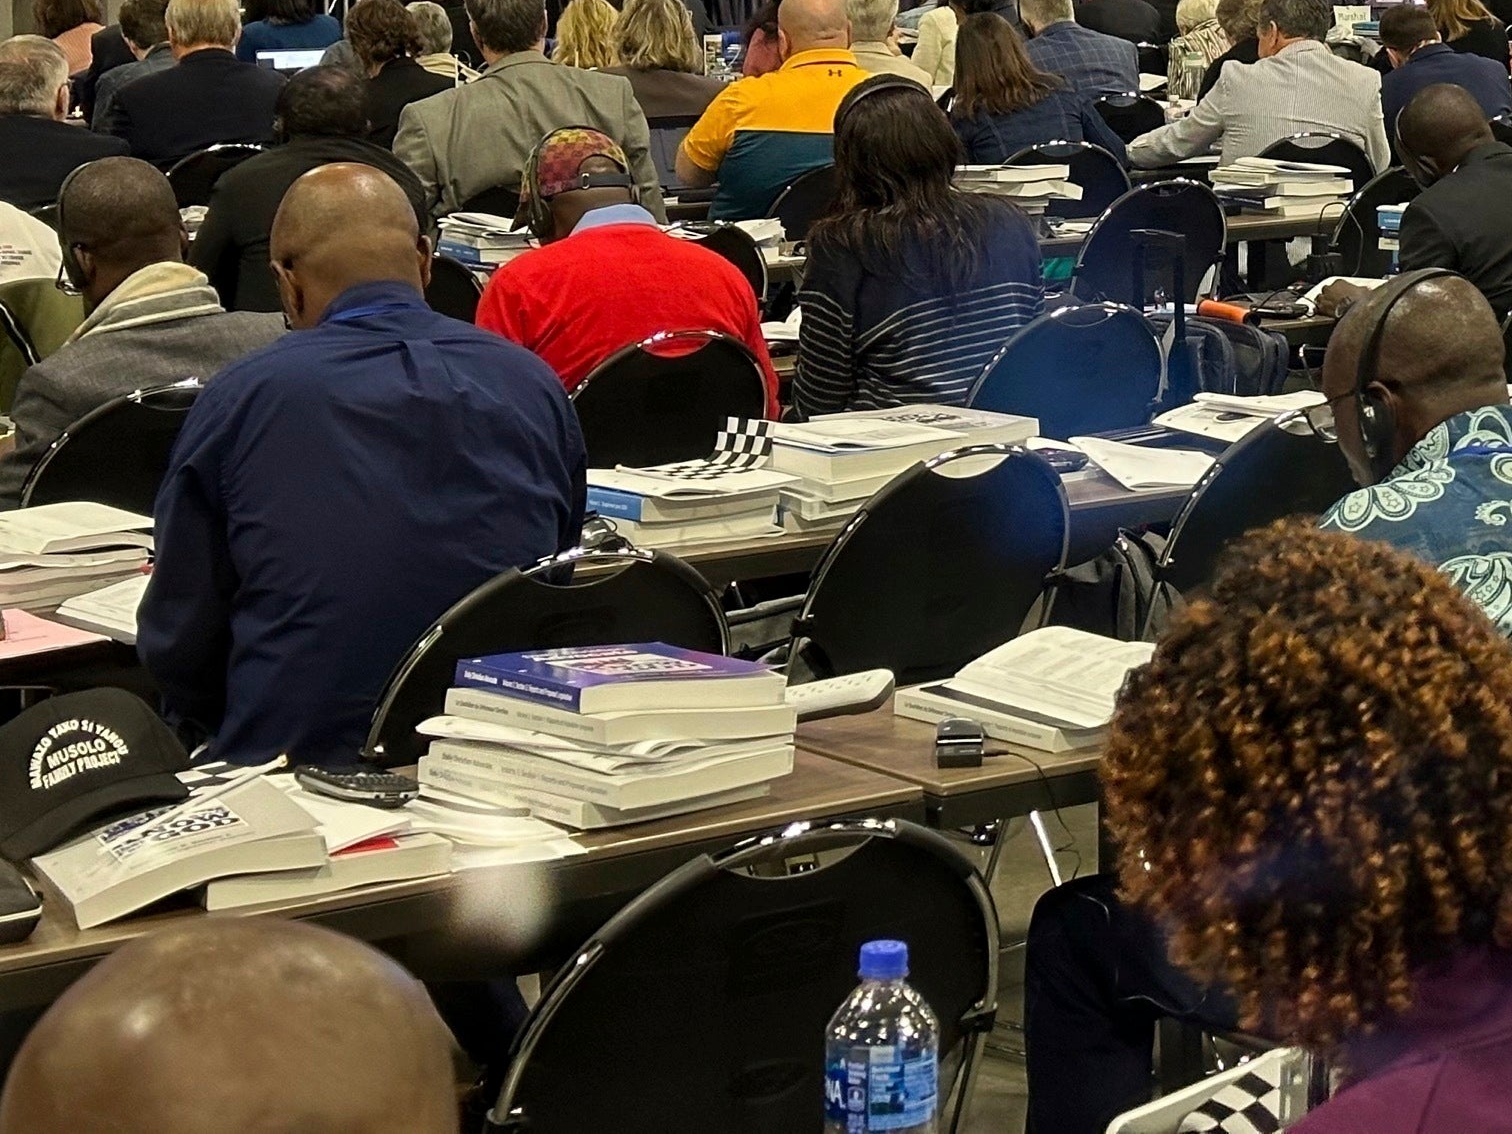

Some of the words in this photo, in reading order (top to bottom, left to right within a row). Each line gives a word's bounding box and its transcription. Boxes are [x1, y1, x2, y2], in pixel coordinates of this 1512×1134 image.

[42, 761, 77, 789] FAMILY
[76, 750, 120, 773] PROJECT
[46, 738, 106, 769] MUSOLO
